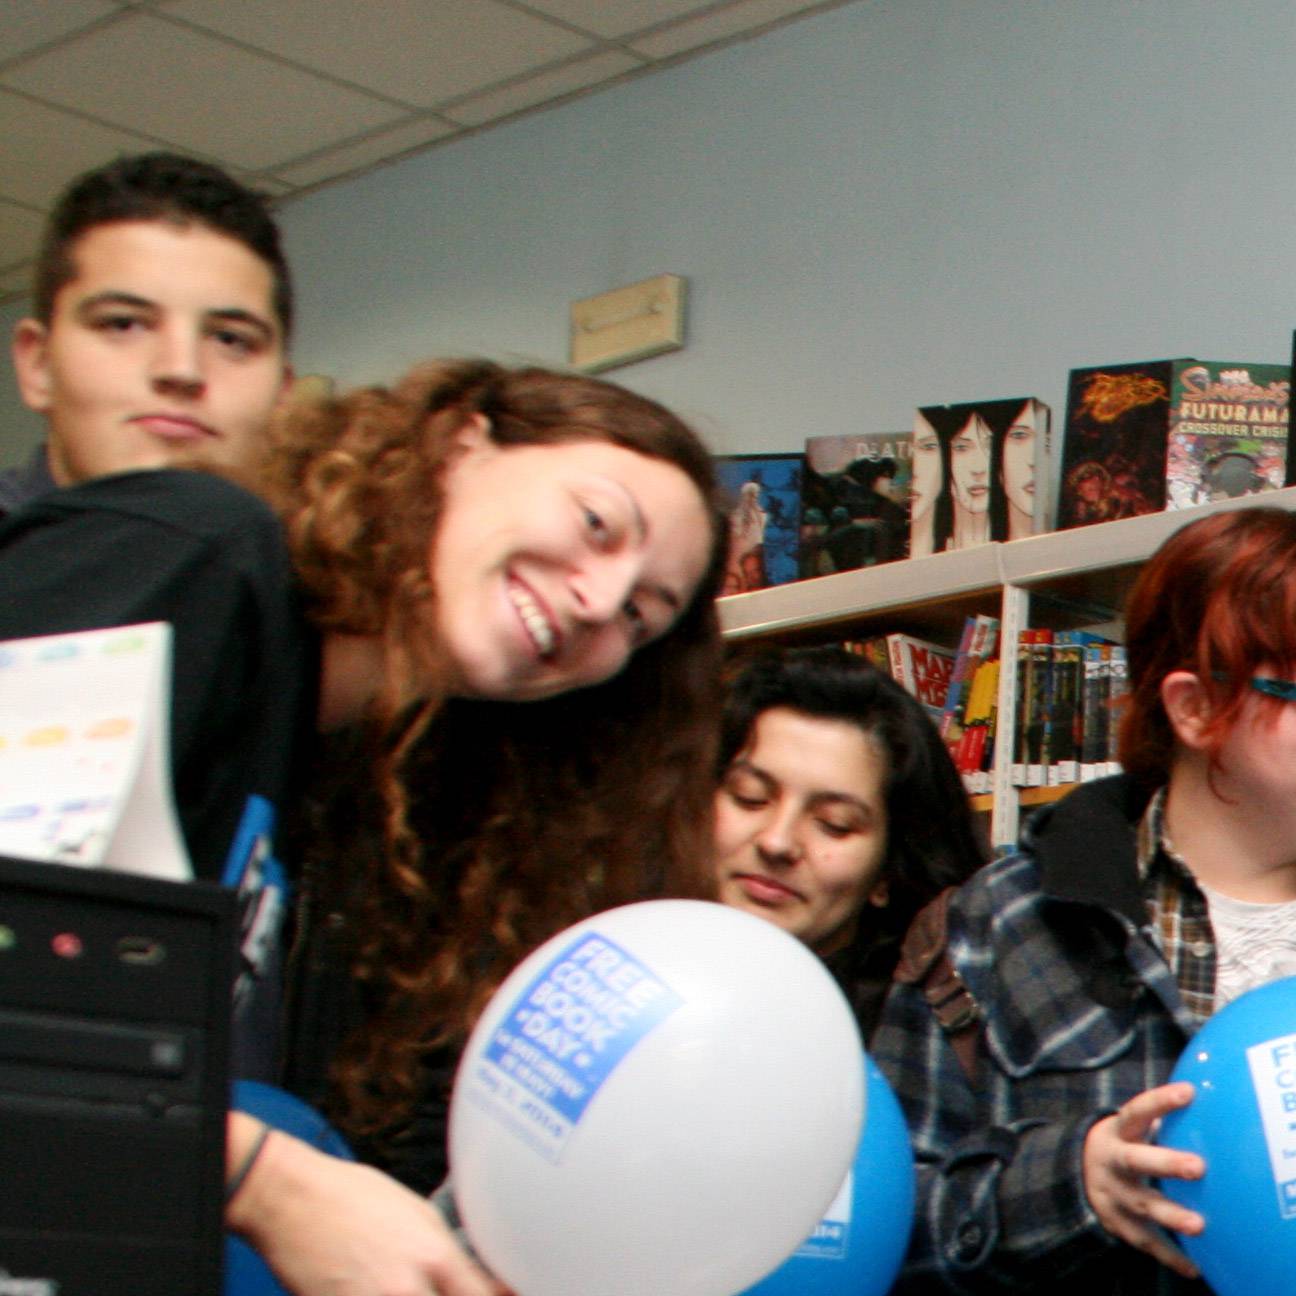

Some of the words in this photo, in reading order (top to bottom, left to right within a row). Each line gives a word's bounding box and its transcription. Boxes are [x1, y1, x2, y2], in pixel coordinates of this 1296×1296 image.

[549, 961, 641, 1031] COMIC
[569, 937, 664, 1009] FREE
[520, 1010, 584, 1060] DAY
[528, 981, 614, 1052] BOOK
